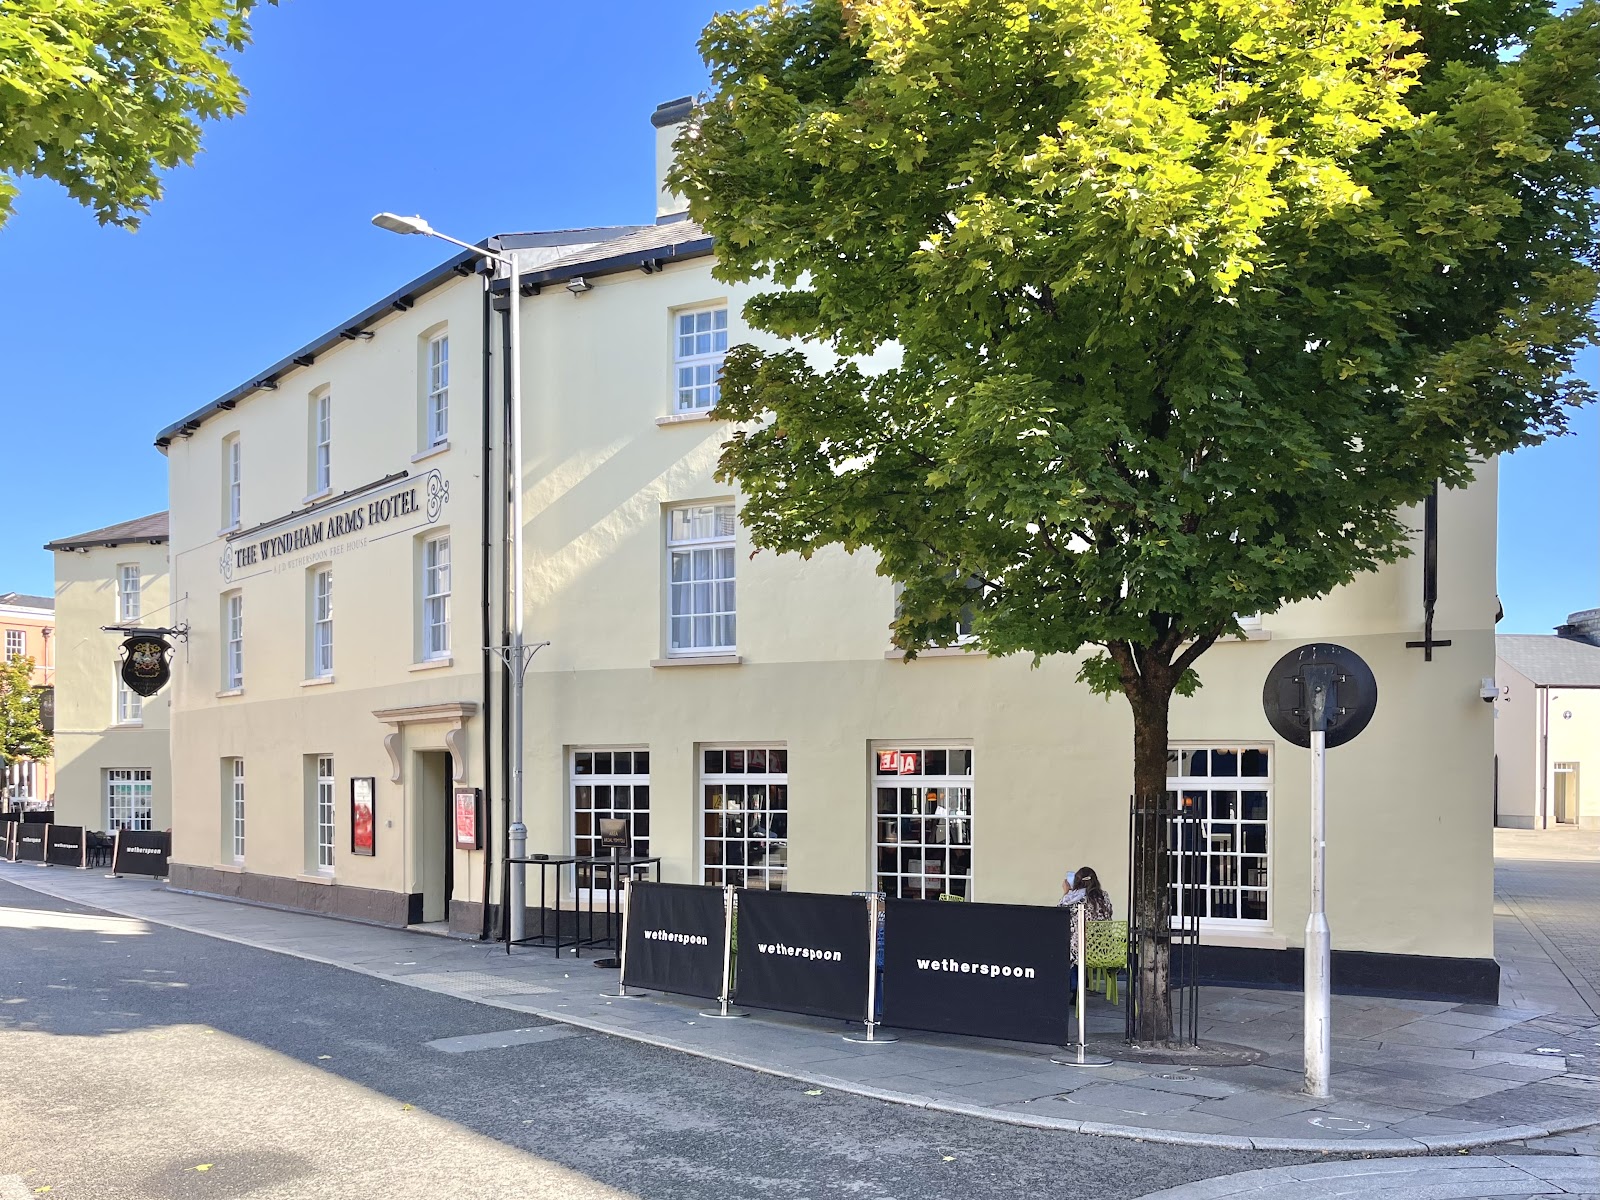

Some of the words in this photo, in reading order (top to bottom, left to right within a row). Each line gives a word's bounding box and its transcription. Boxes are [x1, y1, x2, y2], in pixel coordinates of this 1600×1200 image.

[235, 544, 257, 569] THE
[260, 521, 324, 561] WYNDHAM
[327, 508, 364, 539] ARMS
[368, 489, 419, 526] HOTEL
[288, 550, 328, 569] WETHERSPOON
[330, 544, 344, 557] FREE
[346, 537, 367, 553] HOUSE
[126, 846, 161, 854] wetherspoon
[644, 929, 708, 946] wetherspoon
[758, 942, 842, 961] wetherspoon
[917, 958, 1035, 979] wetherspoon
